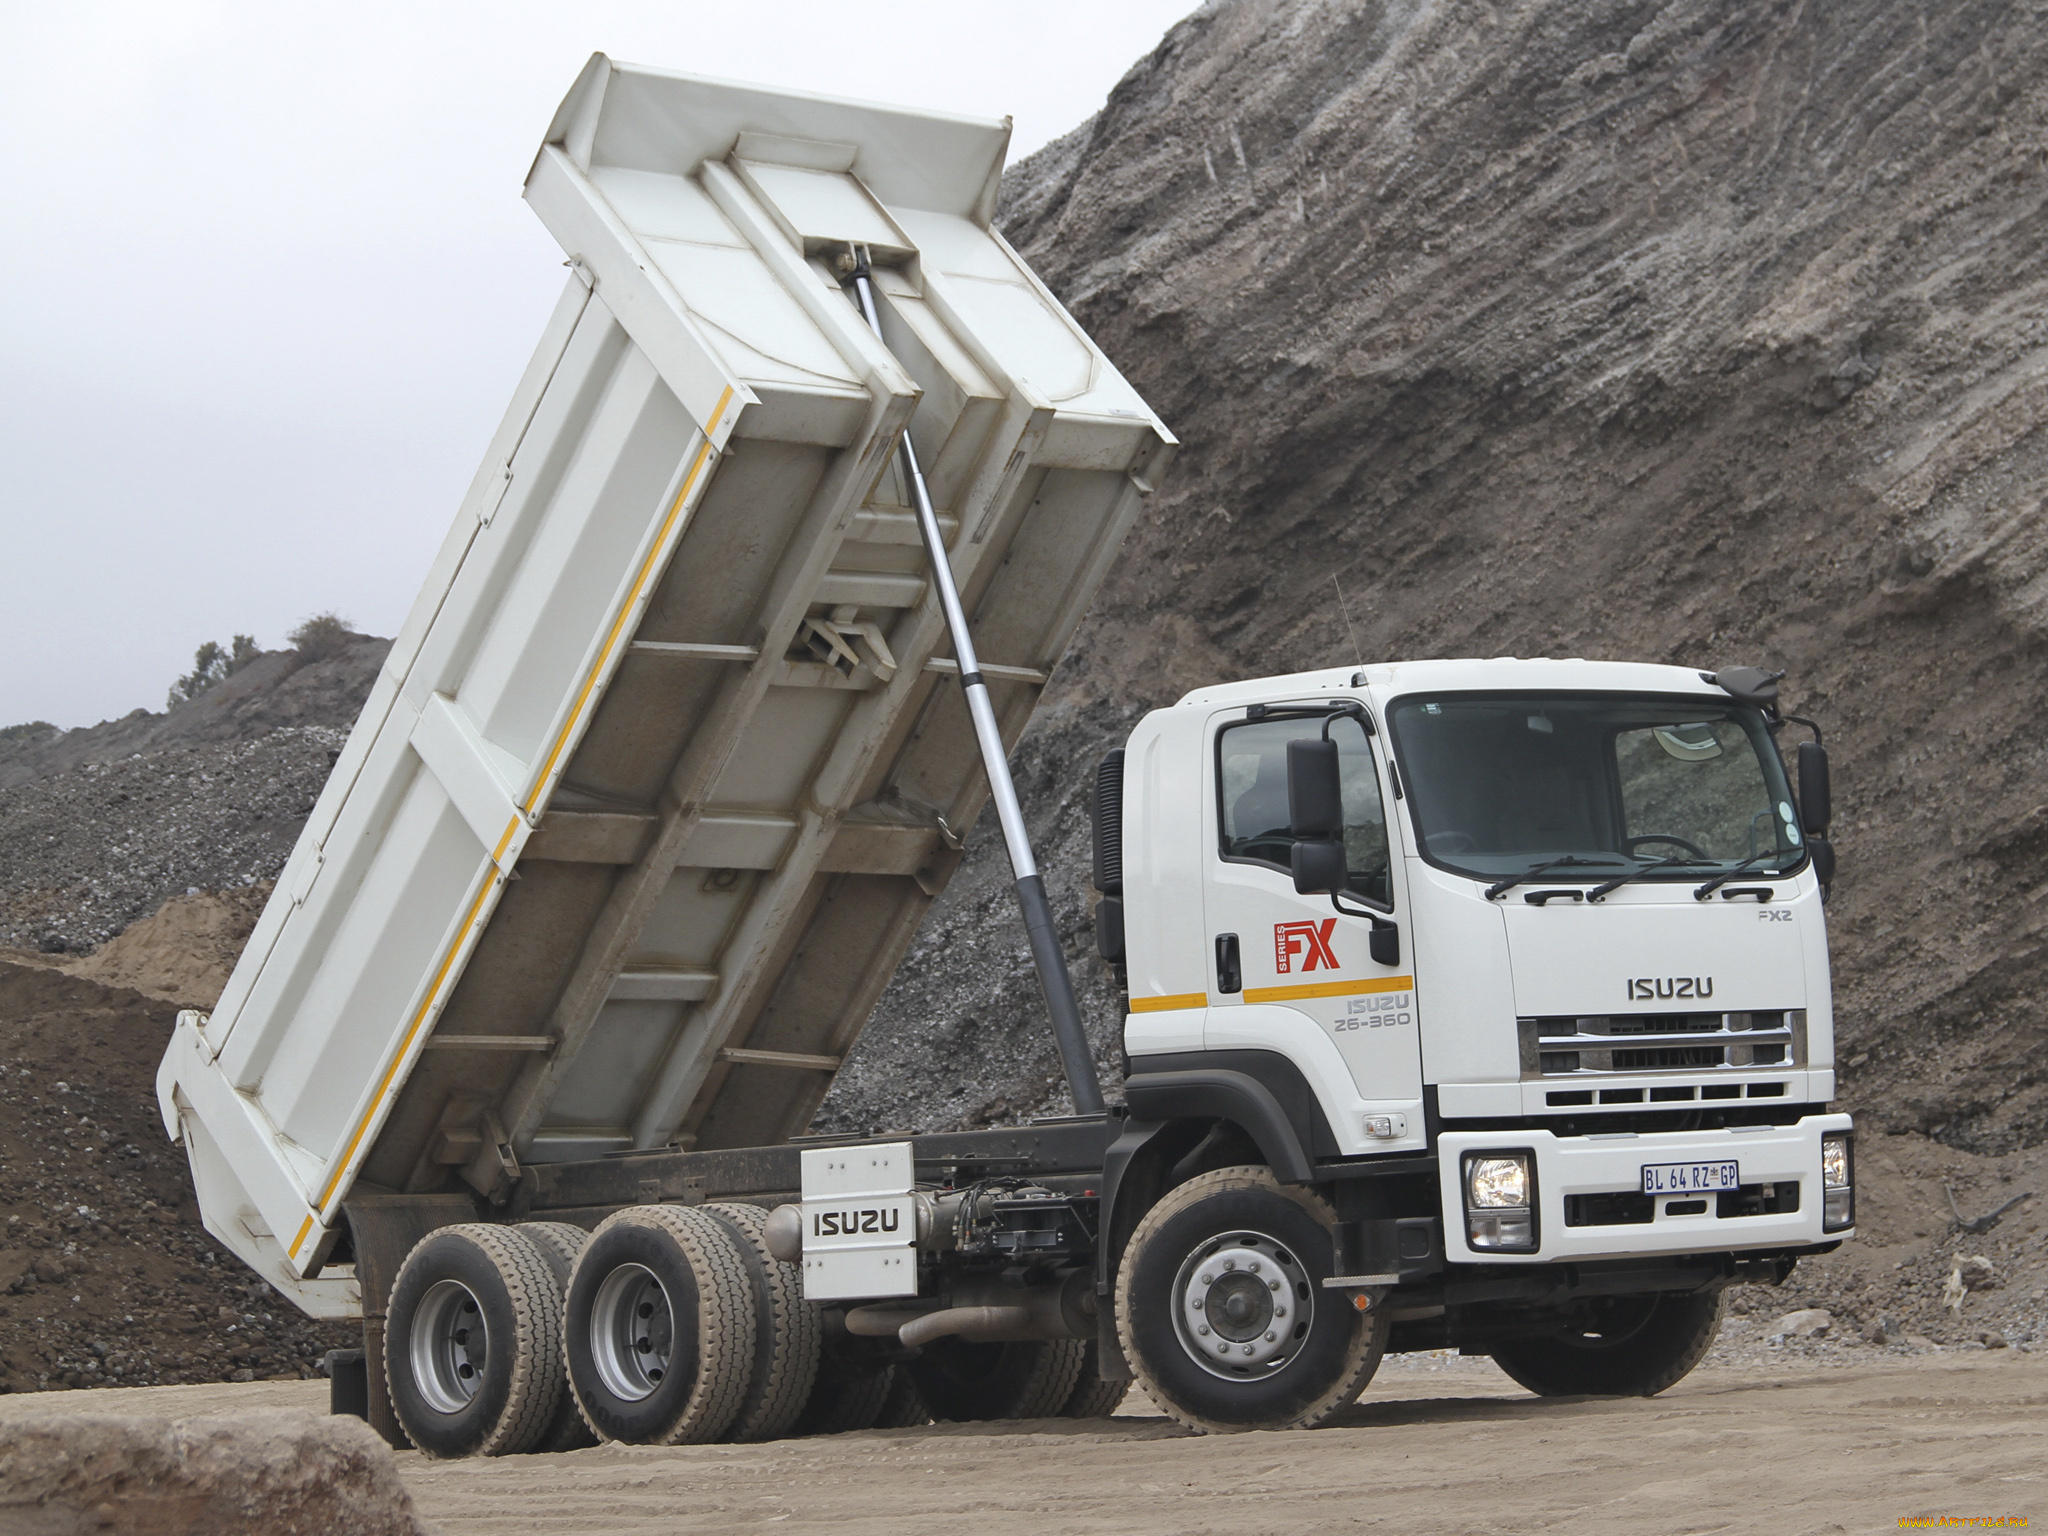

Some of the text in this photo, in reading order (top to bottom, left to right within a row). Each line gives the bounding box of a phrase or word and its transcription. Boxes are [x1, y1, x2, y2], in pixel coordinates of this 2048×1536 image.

[1277, 925, 1288, 971] SERIES
[1627, 977, 1713, 1001] ISUZU
[1347, 994, 1410, 1014] ISUZU
[1334, 1012, 1411, 1032] 26-360
[1645, 1165, 1736, 1190] BL 64 RZ GP
[814, 1208, 898, 1236] ISUZU
